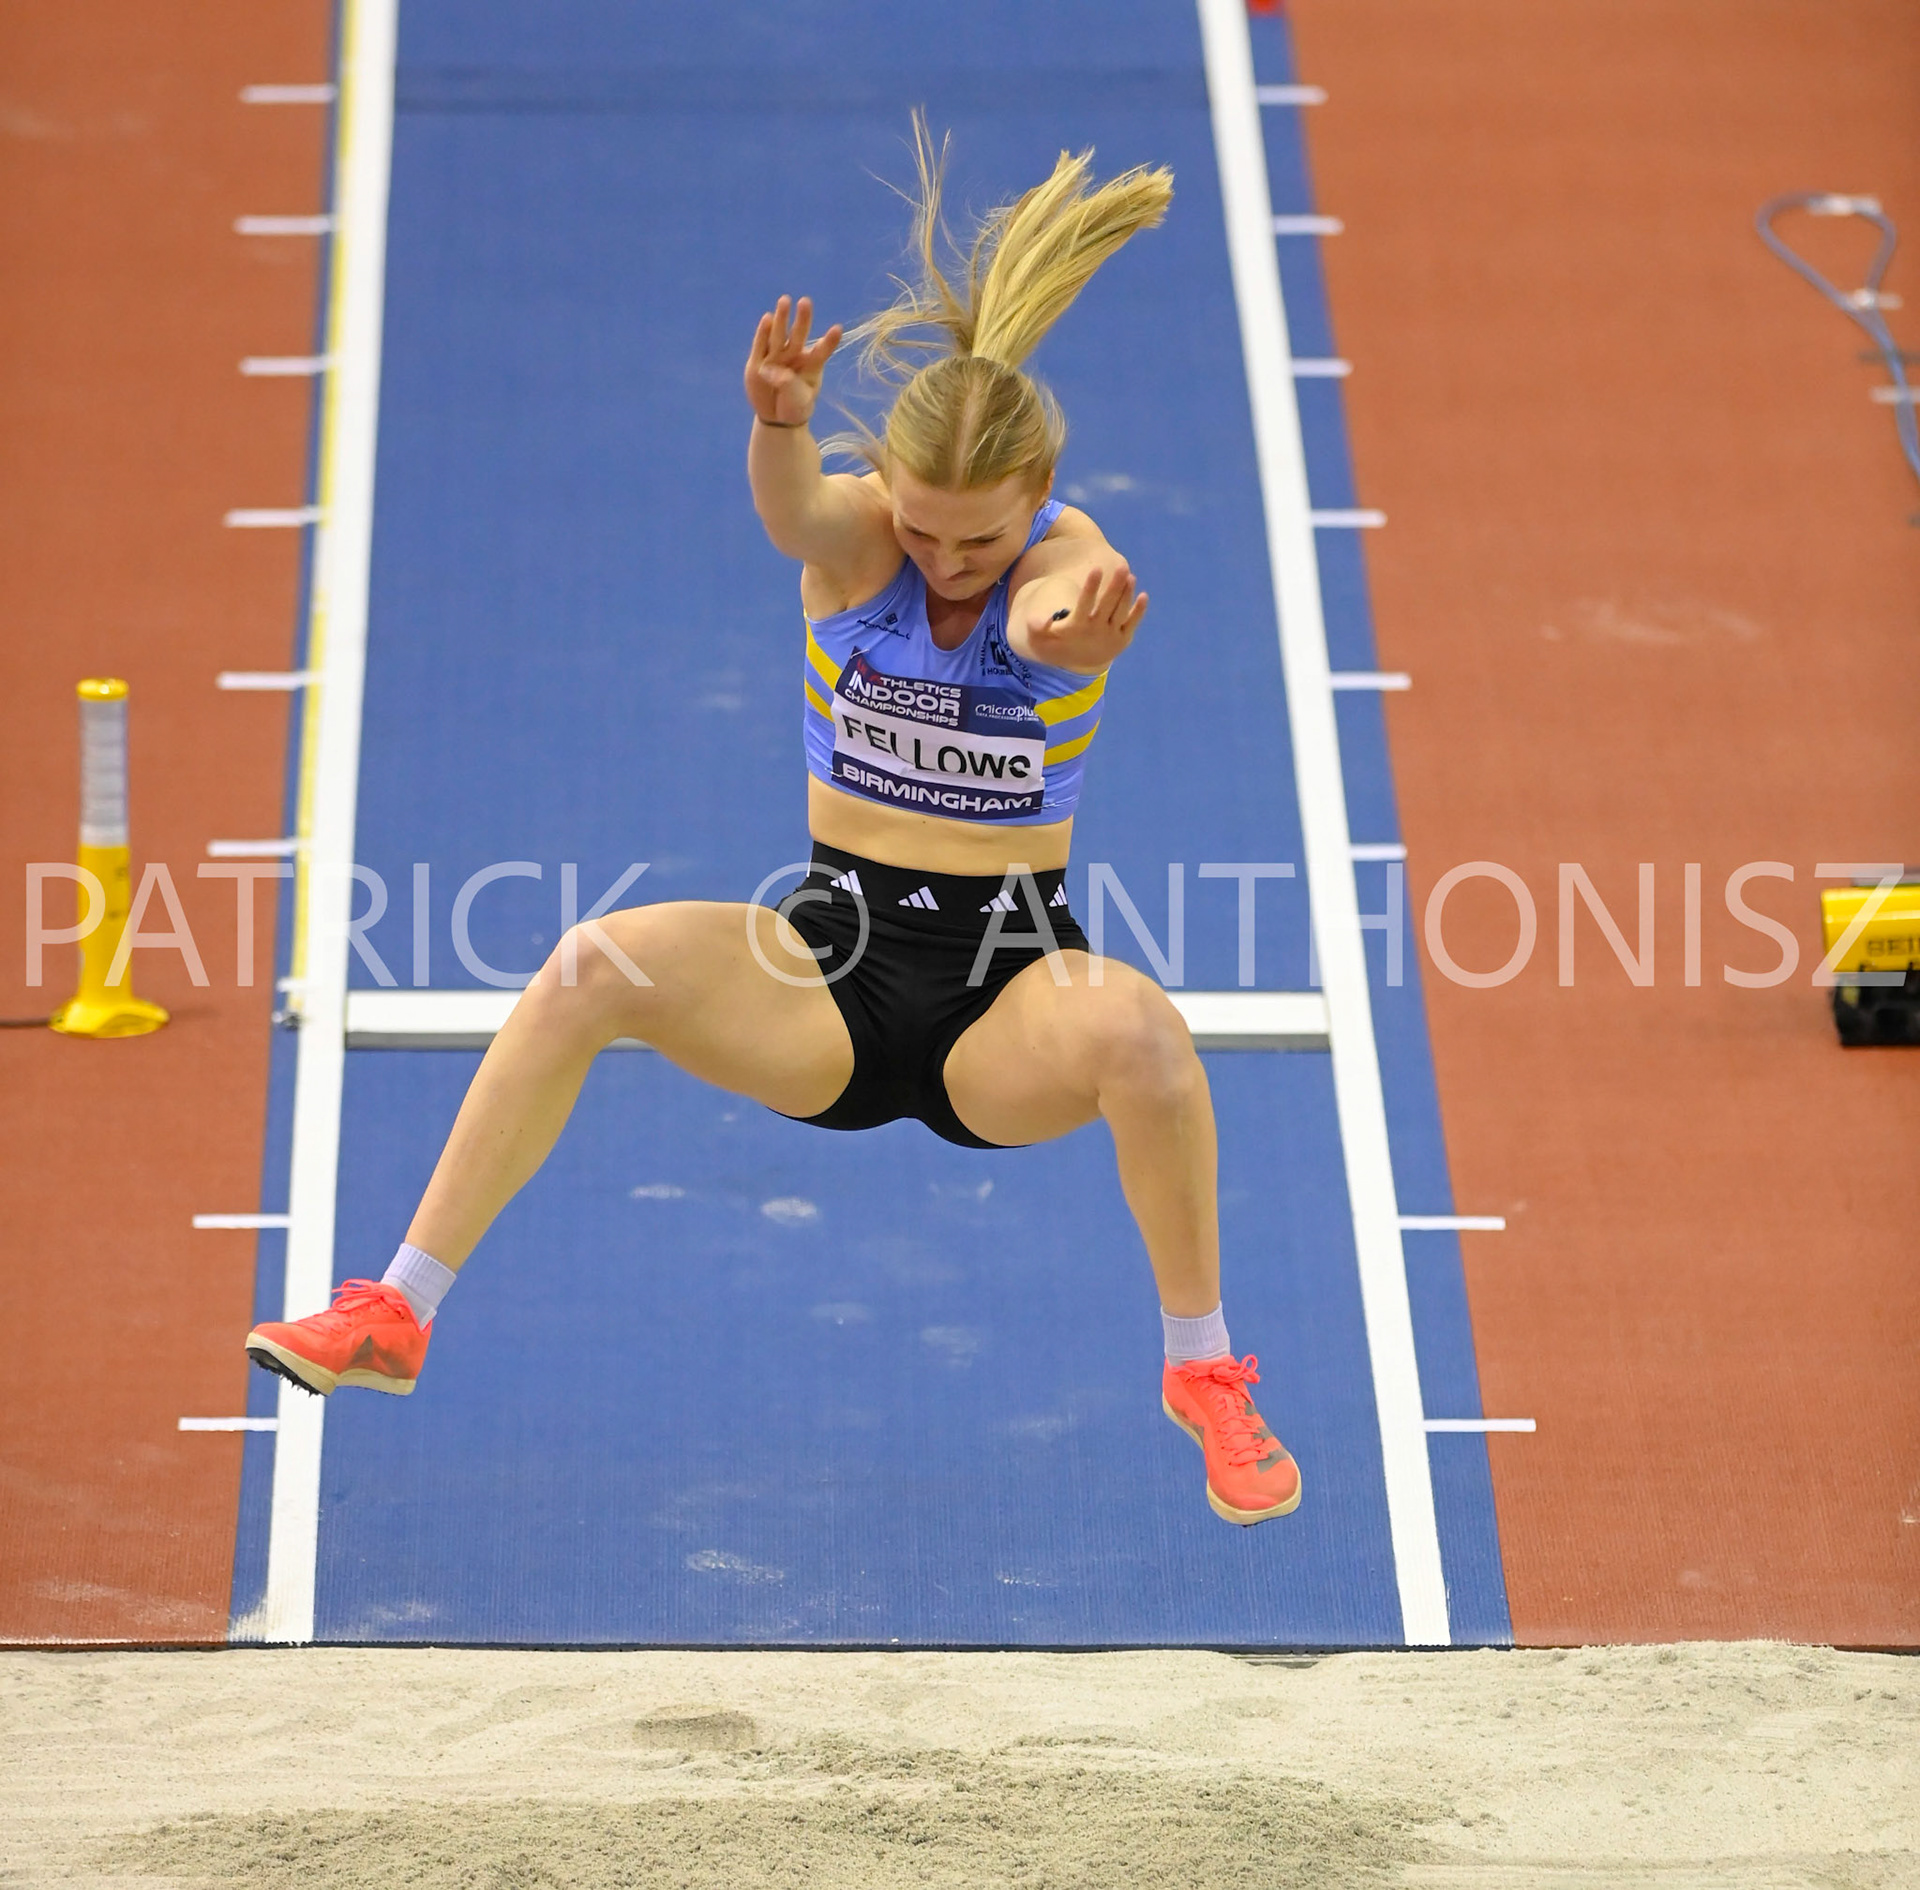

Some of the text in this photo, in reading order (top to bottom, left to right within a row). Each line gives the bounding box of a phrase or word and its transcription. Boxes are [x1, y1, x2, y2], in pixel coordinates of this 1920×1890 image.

[844, 689, 959, 727] CHAMPIONSHIPS
[848, 670, 961, 717] INDOOR
[842, 762, 1033, 813] BIRMINGHAM
